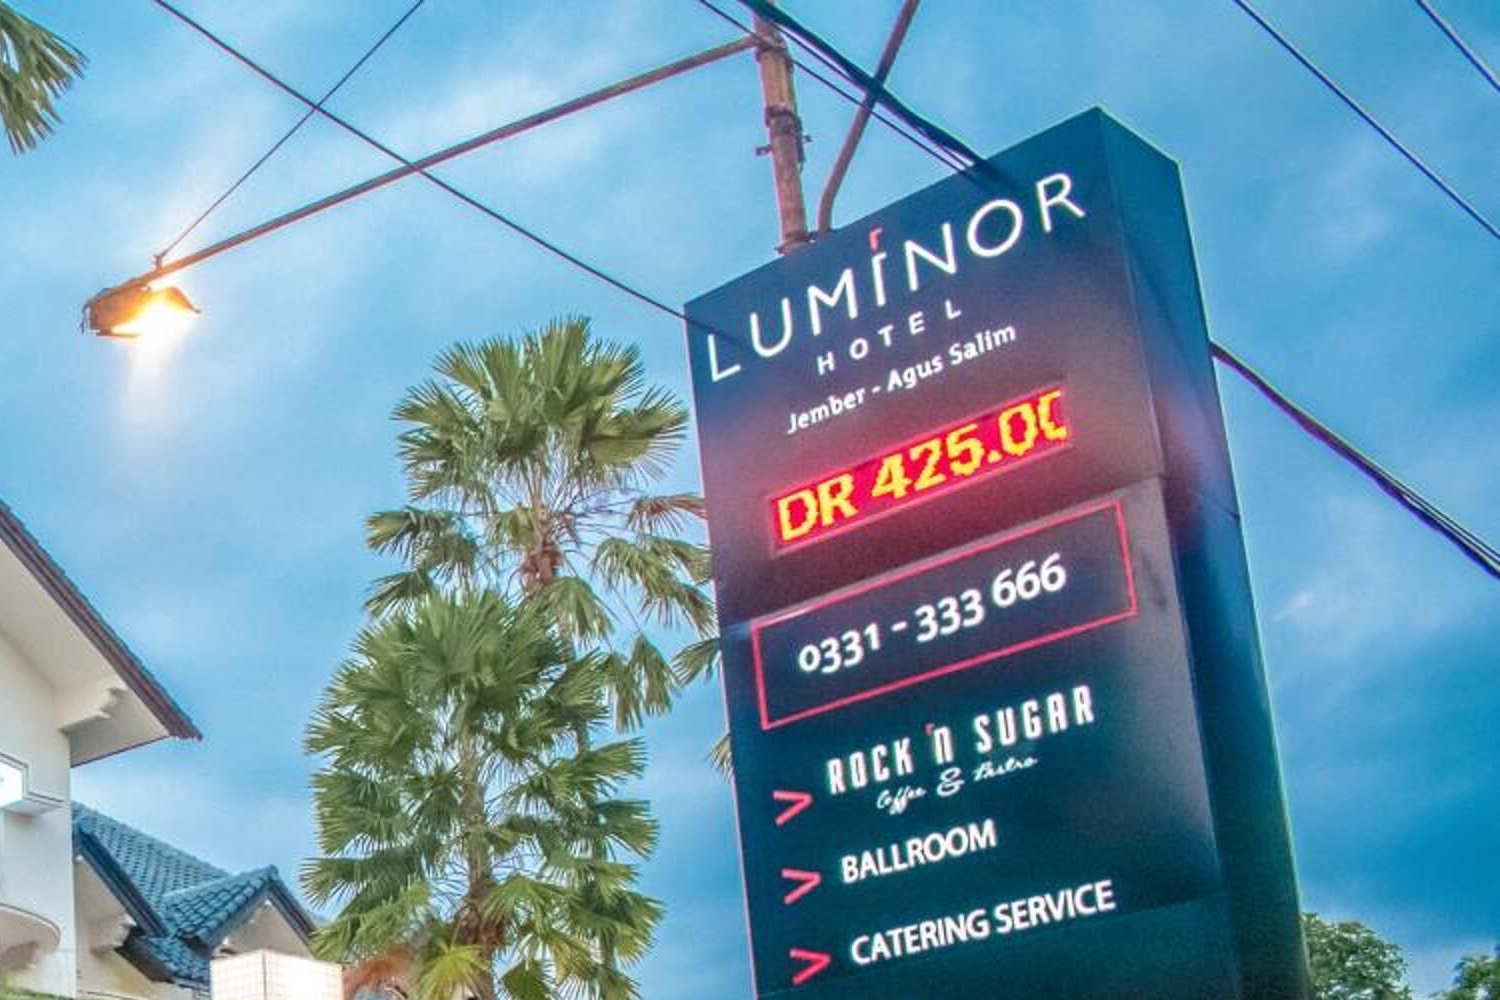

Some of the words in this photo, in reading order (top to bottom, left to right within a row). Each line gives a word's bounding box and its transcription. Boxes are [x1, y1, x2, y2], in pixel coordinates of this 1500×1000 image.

[816, 299, 962, 375] HOTEL
[787, 387, 866, 435] Jember
[886, 355, 944, 392] Agus
[948, 325, 1017, 366] Salim
[777, 473, 858, 541] DR
[798, 623, 881, 675] 0331
[915, 589, 986, 642] 333
[990, 553, 1067, 607] 666
[827, 737, 914, 795] ROCK
[973, 684, 1094, 753] SUGAR
[876, 784, 926, 815] Coffee
[937, 767, 964, 796] &
[841, 818, 997, 884] BALLROOM
[850, 904, 990, 966] CATERING
[995, 879, 1116, 935] SERVICE
